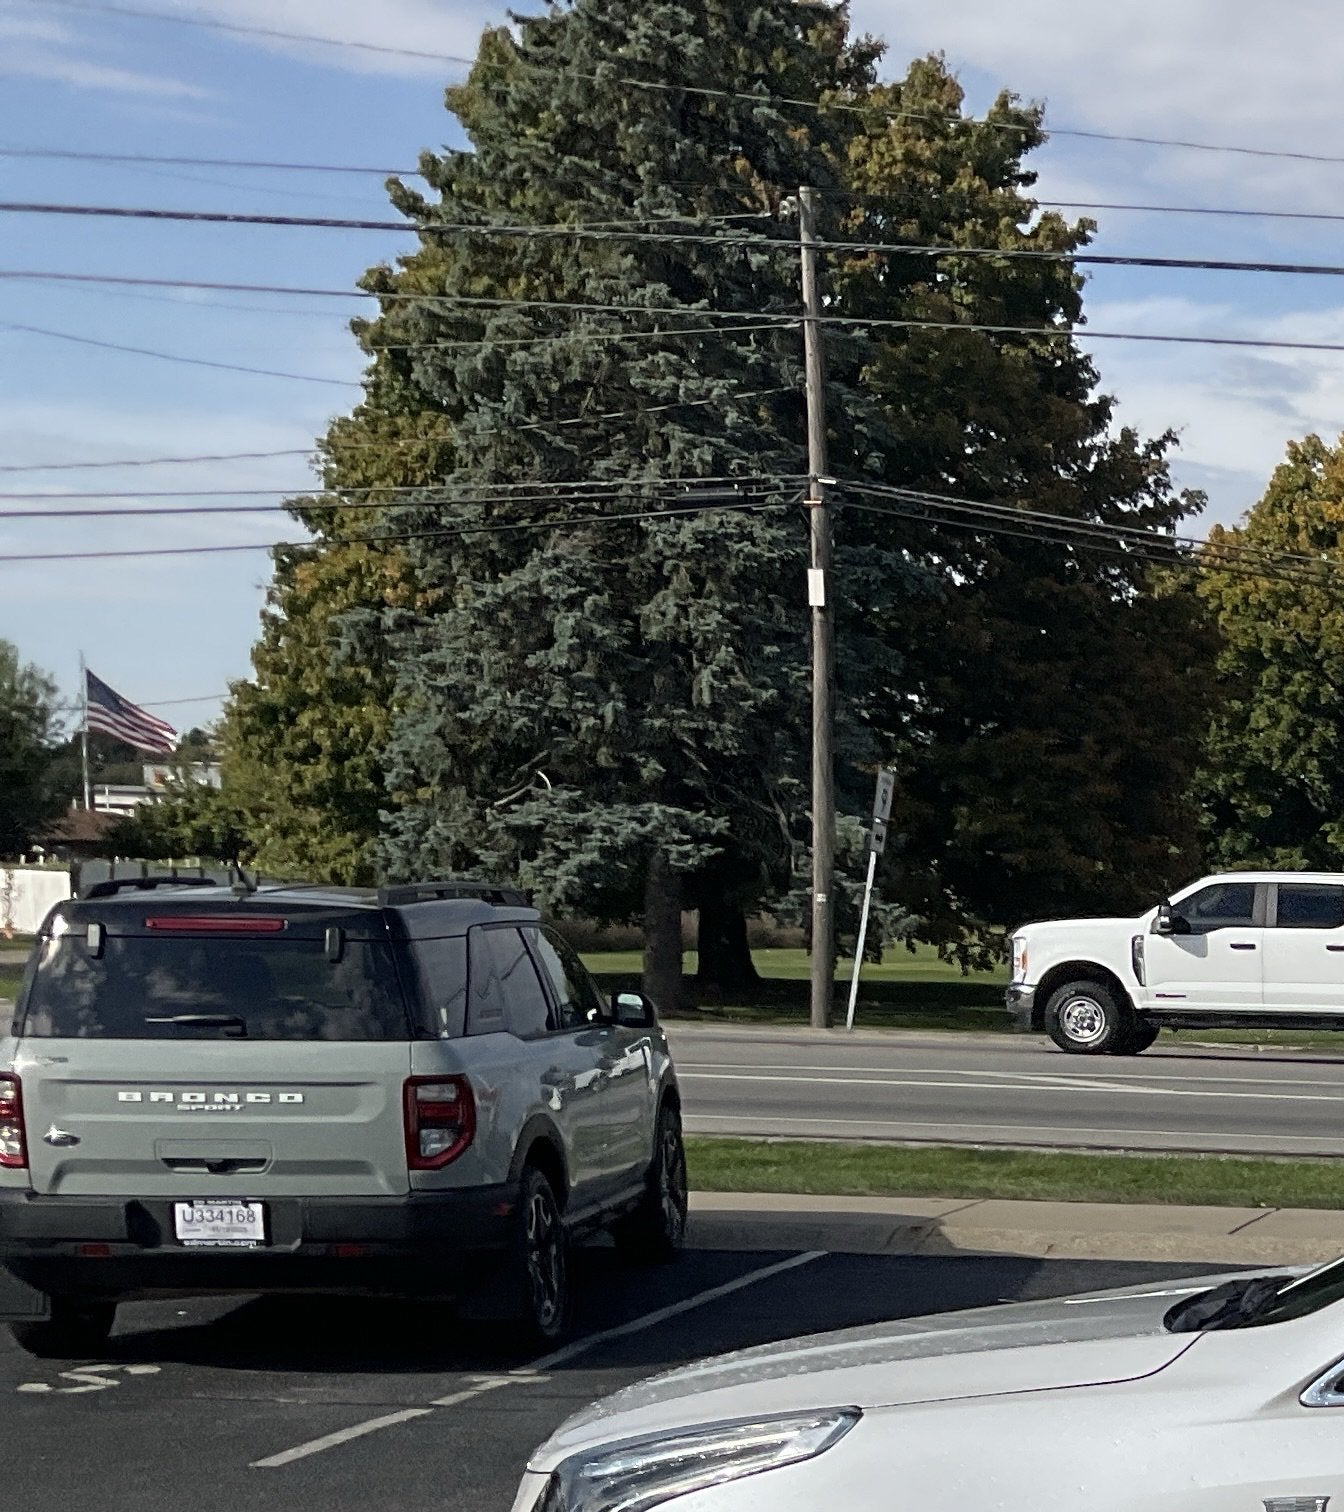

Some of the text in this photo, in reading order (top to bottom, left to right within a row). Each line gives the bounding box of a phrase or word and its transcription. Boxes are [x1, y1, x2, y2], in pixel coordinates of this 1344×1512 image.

[118, 1091, 304, 1103] BRONCO
[177, 1103, 244, 1111] SPORT
[182, 1209, 257, 1224] U334168
